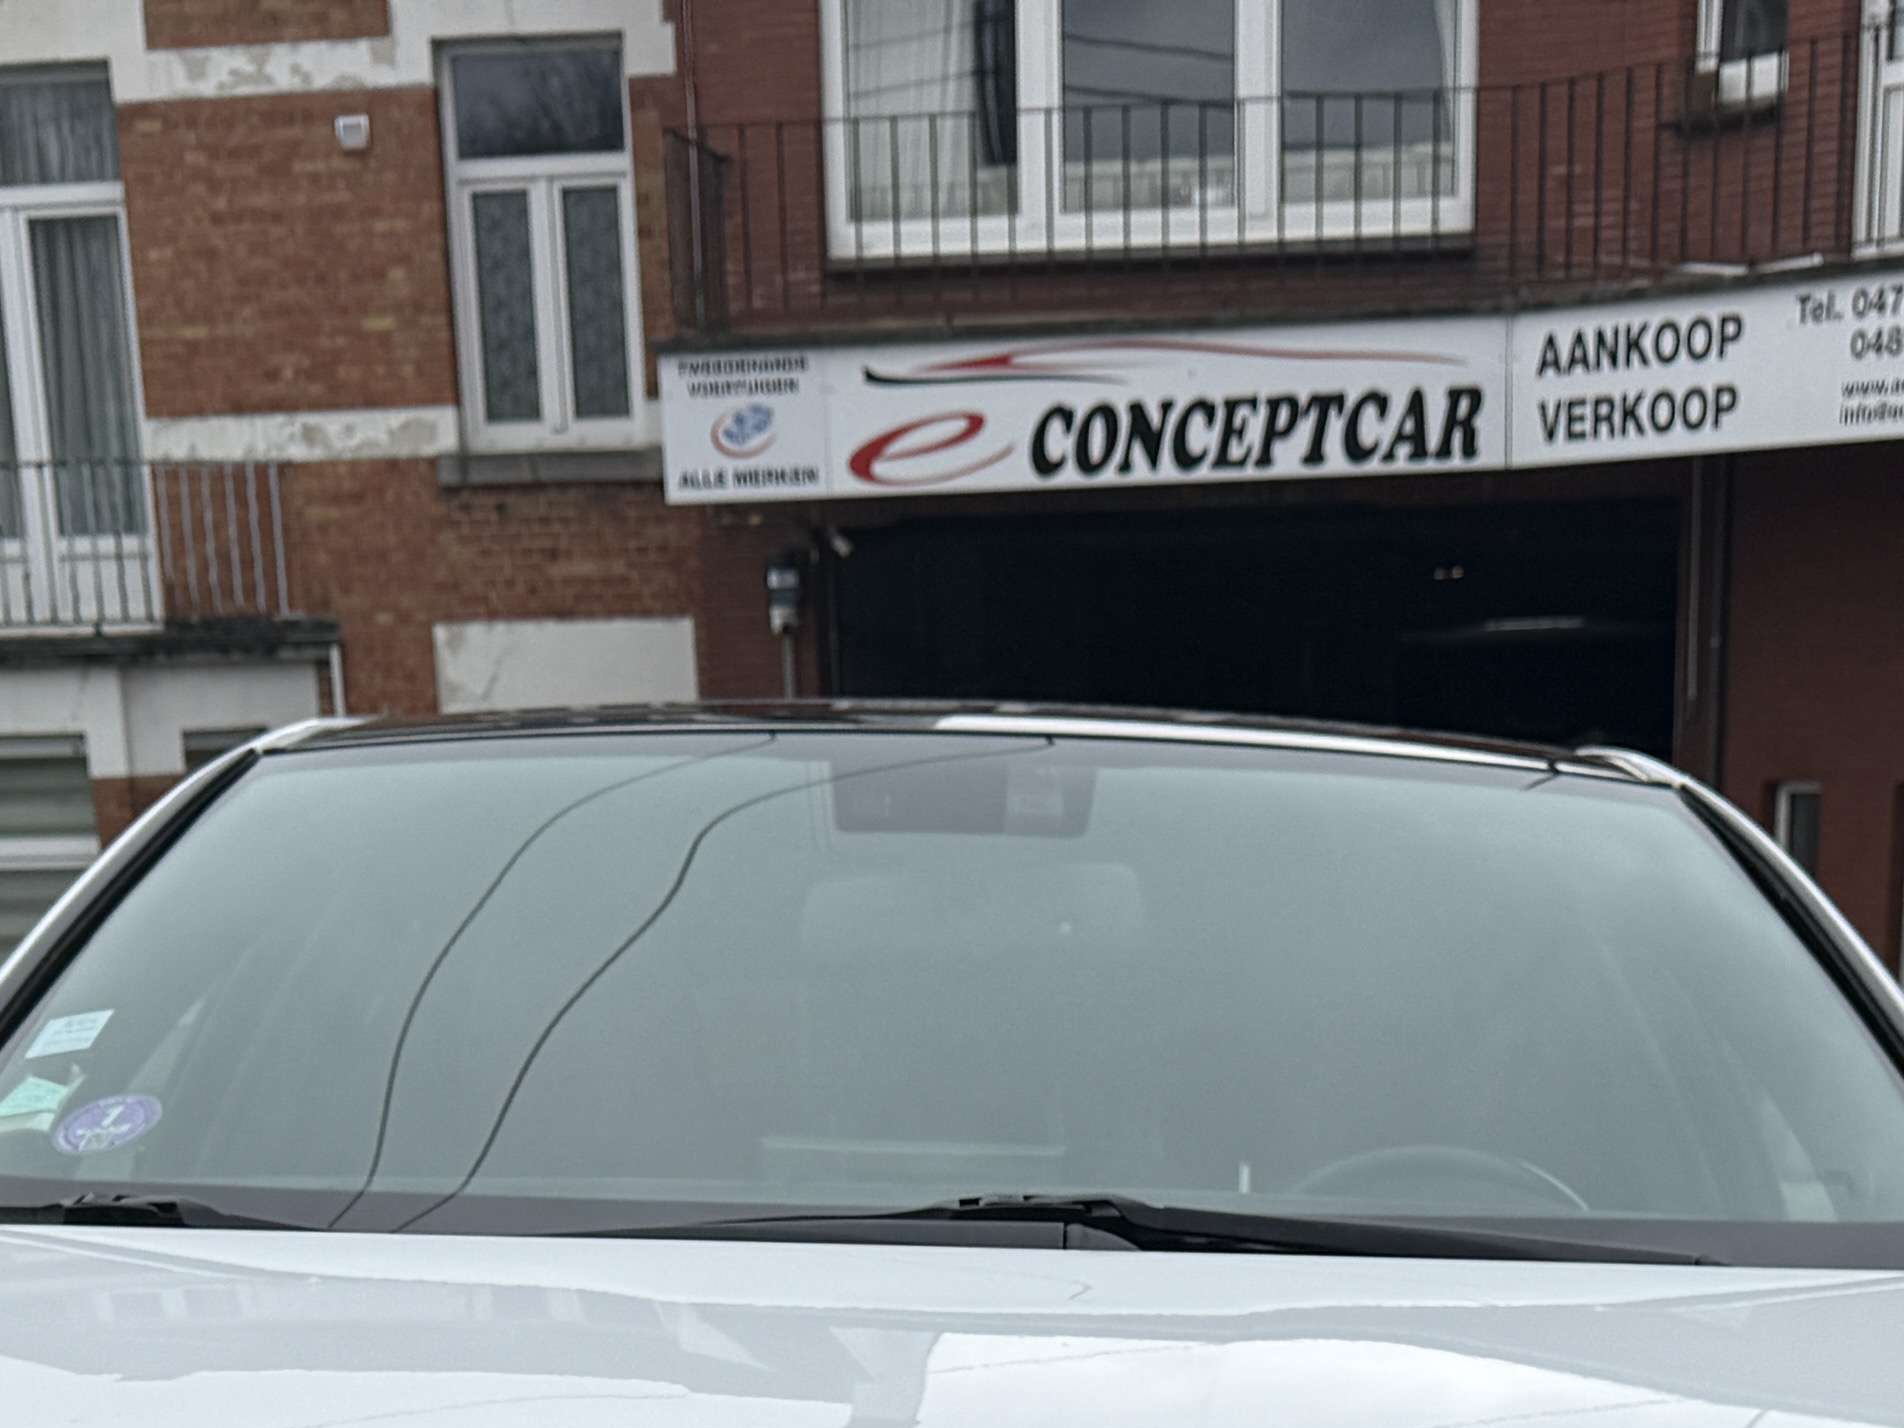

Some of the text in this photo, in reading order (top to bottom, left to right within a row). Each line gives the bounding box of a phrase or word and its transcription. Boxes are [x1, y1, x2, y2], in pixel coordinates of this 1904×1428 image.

[1798, 291, 1843, 324] Tel.
[1536, 312, 1744, 378] AANKOOP
[1537, 384, 1739, 443] VERKOOP
[679, 468, 726, 489] ALLE
